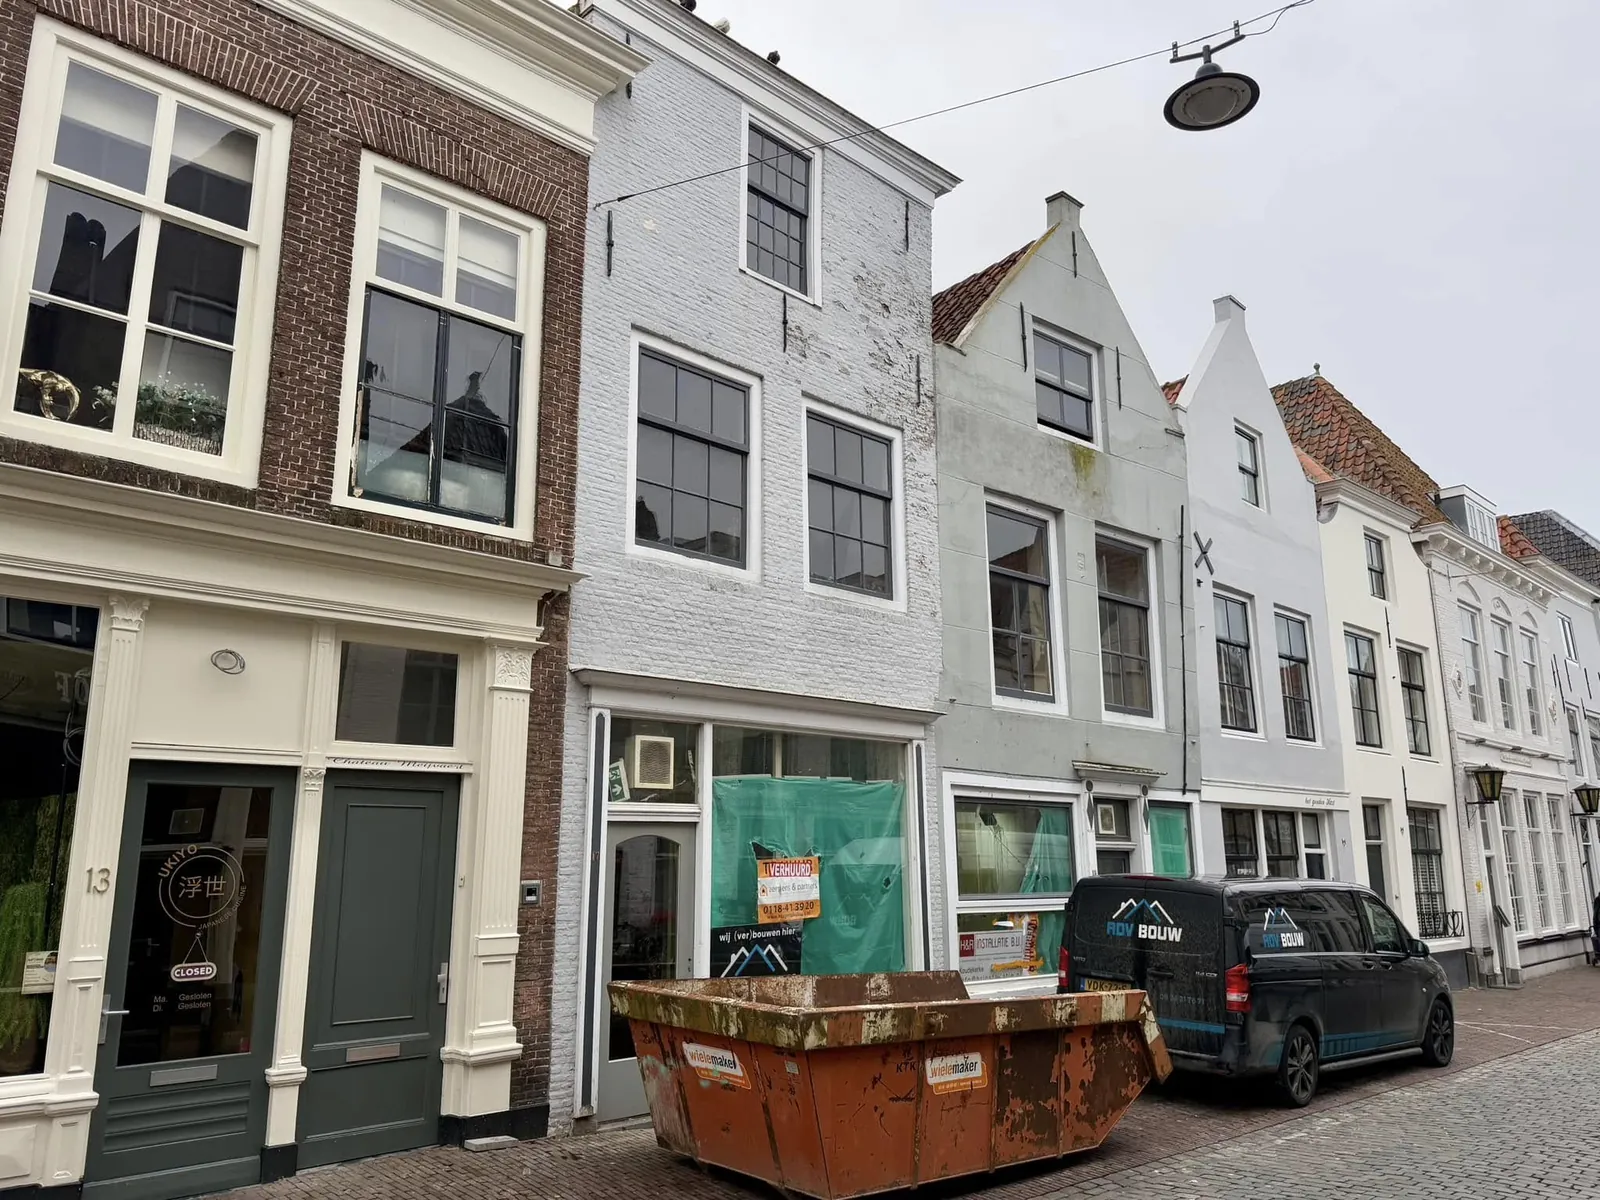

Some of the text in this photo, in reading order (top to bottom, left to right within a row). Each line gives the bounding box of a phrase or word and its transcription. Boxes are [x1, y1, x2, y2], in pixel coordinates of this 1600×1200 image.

[158, 844, 198, 878] UKIYO
[769, 862, 812, 877] VERHUURD
[86, 867, 110, 894] 13
[178, 875, 227, 898] 浮世
[719, 931, 731, 943] wij
[782, 927, 796, 936] hier
[1138, 923, 1182, 943] BOUW
[1280, 932, 1304, 948] BOUW
[976, 936, 1009, 949] INSTALLATIE
[174, 967, 213, 977] CLOSED
[178, 992, 212, 1001] Gesloten
[177, 1001, 211, 1010] Gesloten
[931, 1060, 978, 1078] wielemaker
